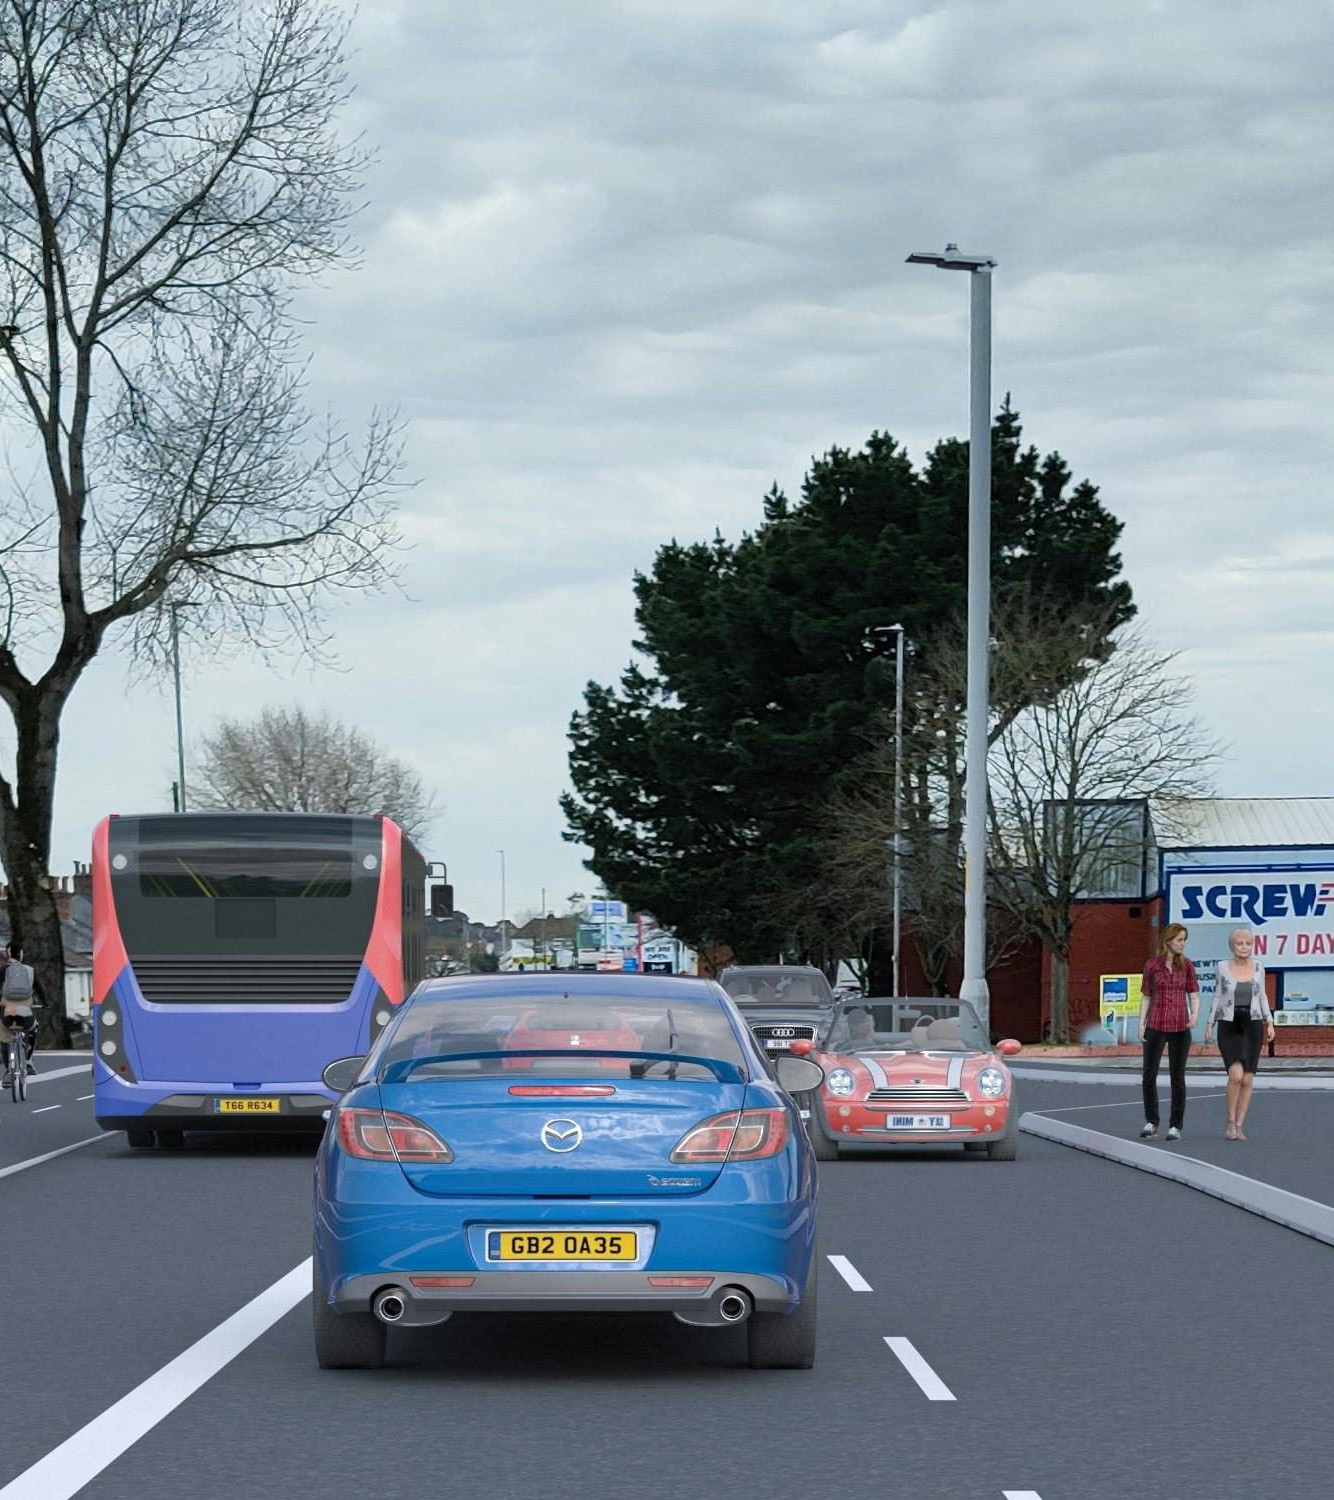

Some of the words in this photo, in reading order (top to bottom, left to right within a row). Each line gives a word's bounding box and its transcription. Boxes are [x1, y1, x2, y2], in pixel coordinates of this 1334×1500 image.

[1276, 935, 1288, 955] 7
[225, 1101, 244, 1110] T66
[247, 1101, 273, 1110] R634
[511, 1236, 554, 1254] GB2
